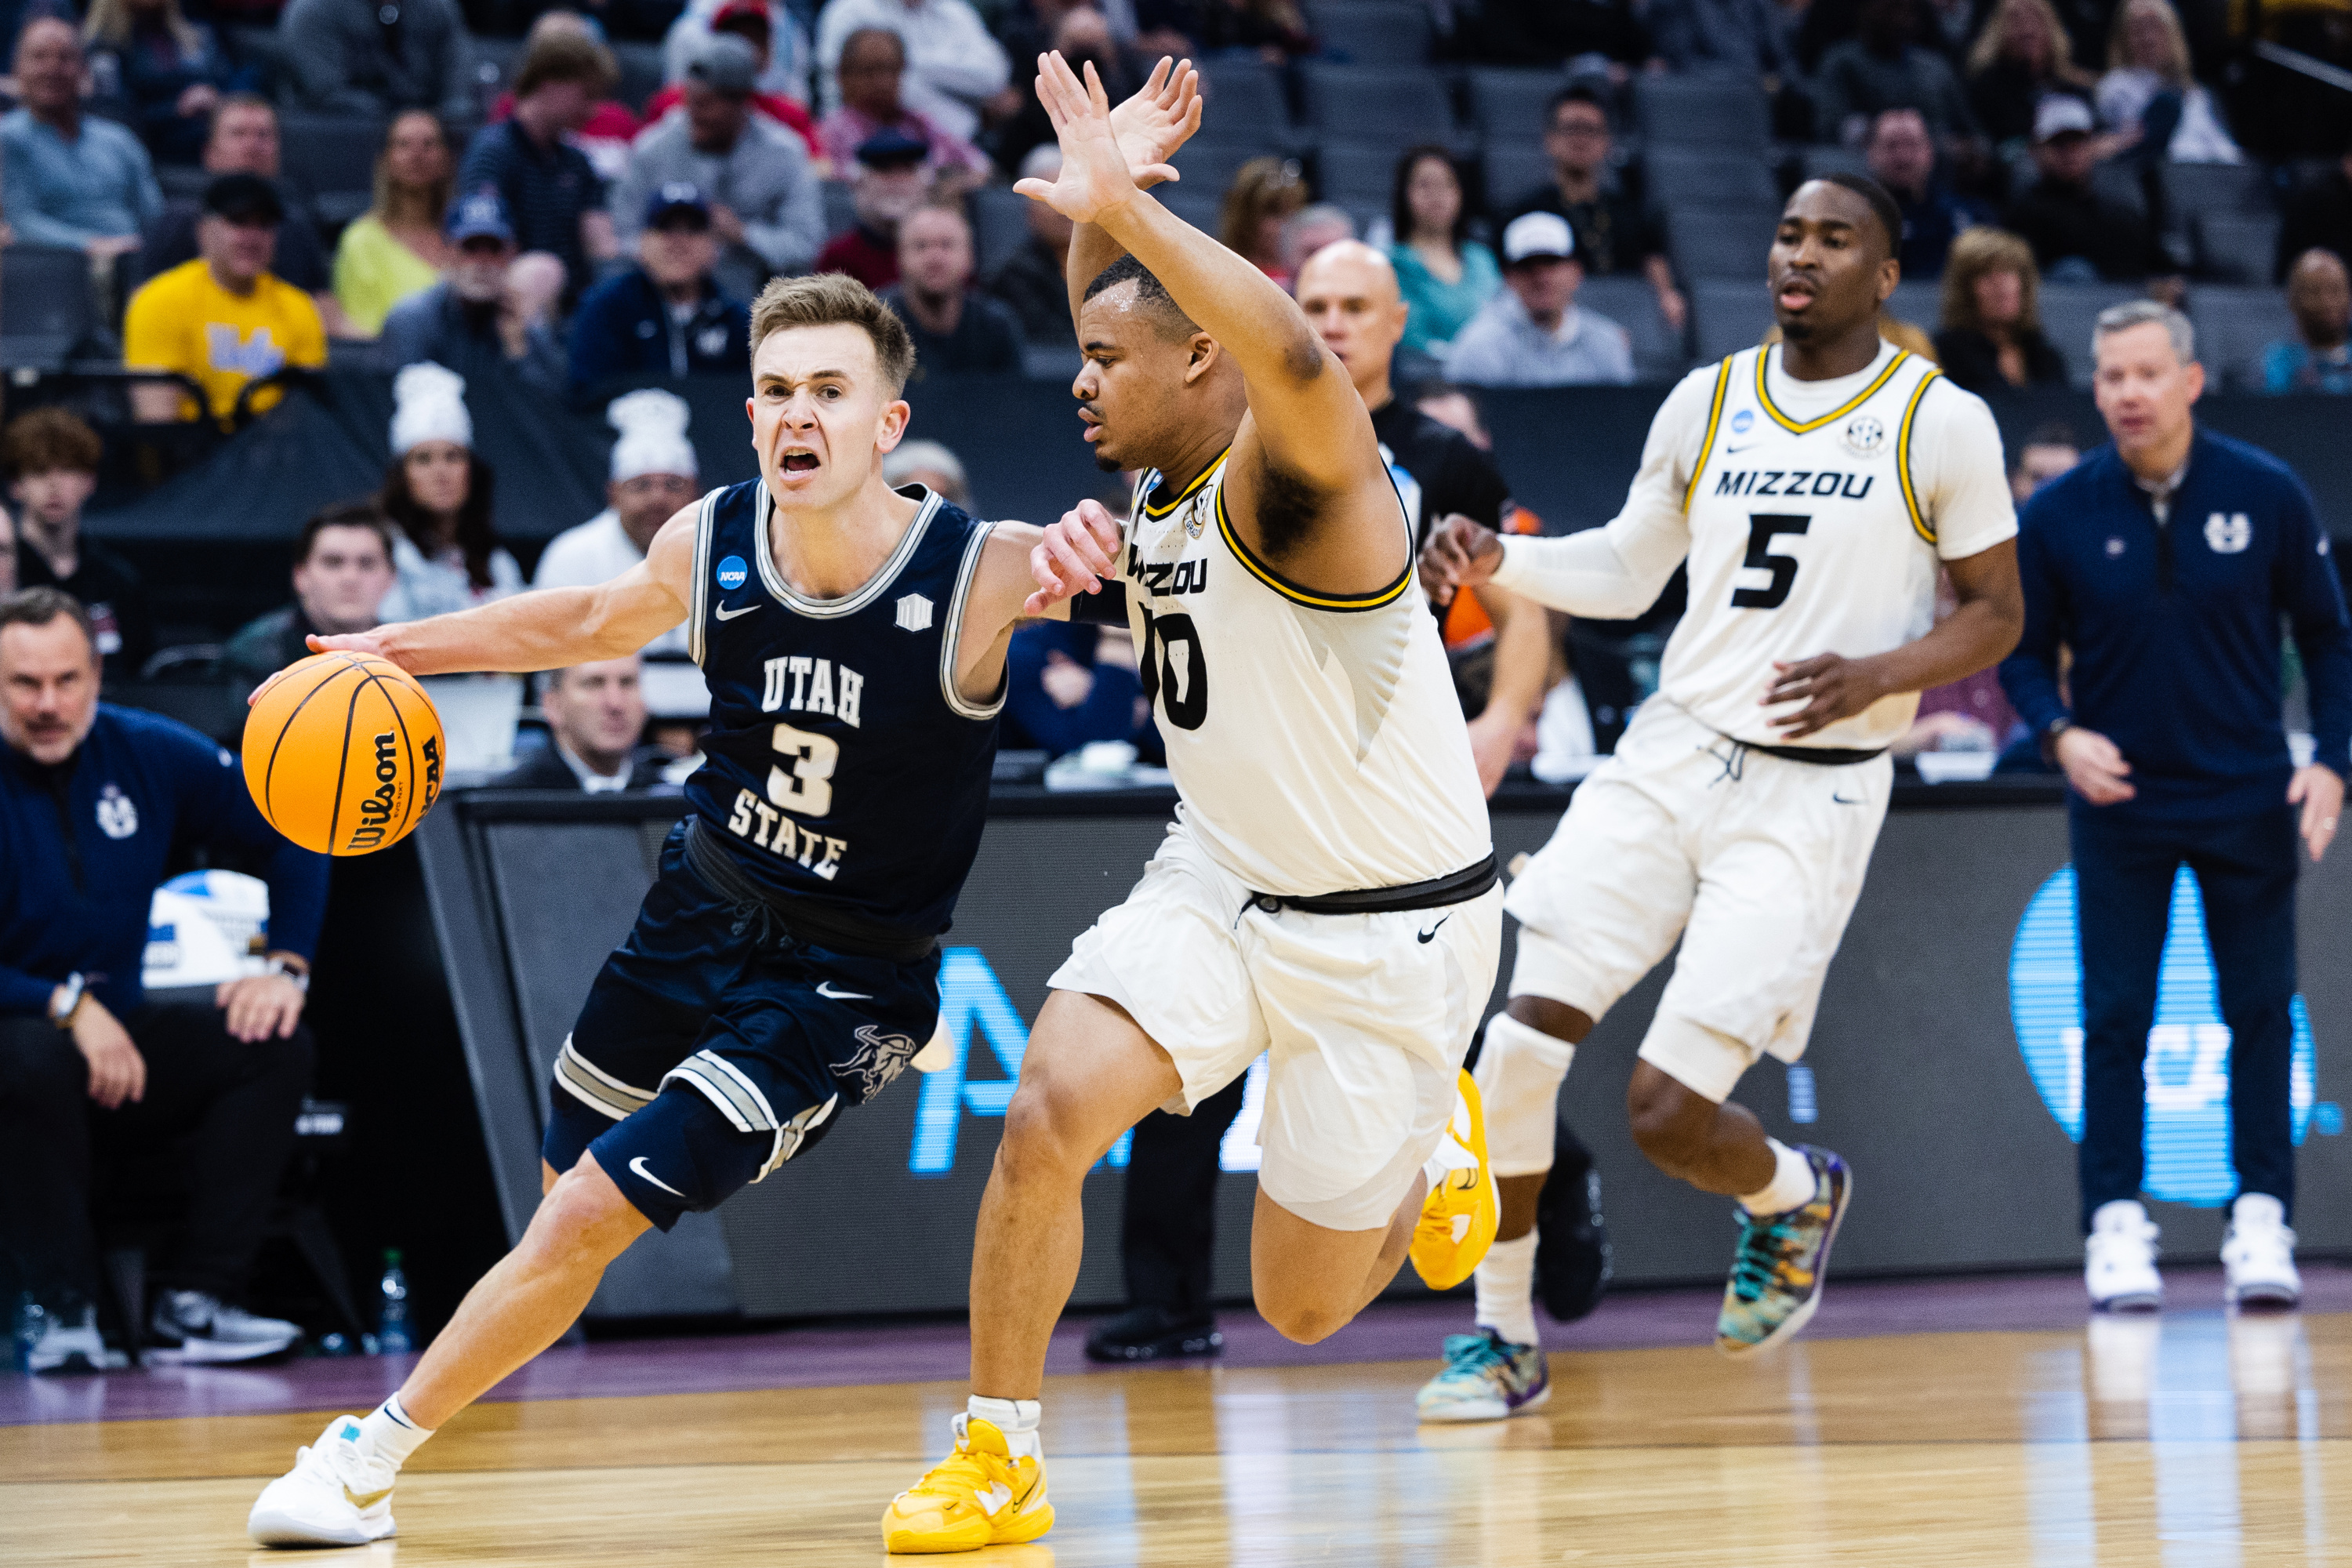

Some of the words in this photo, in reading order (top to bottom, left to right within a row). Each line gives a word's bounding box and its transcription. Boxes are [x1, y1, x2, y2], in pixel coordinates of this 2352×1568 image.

[1715, 471, 1874, 499] MIZZOU
[720, 571, 746, 582] NCAA
[1730, 514, 1813, 609] 5
[761, 655, 864, 728] UTAH
[1138, 601, 1208, 731] 10
[346, 731, 397, 850] Wilson
[767, 722, 840, 818] 3
[728, 788, 848, 881] STATE
